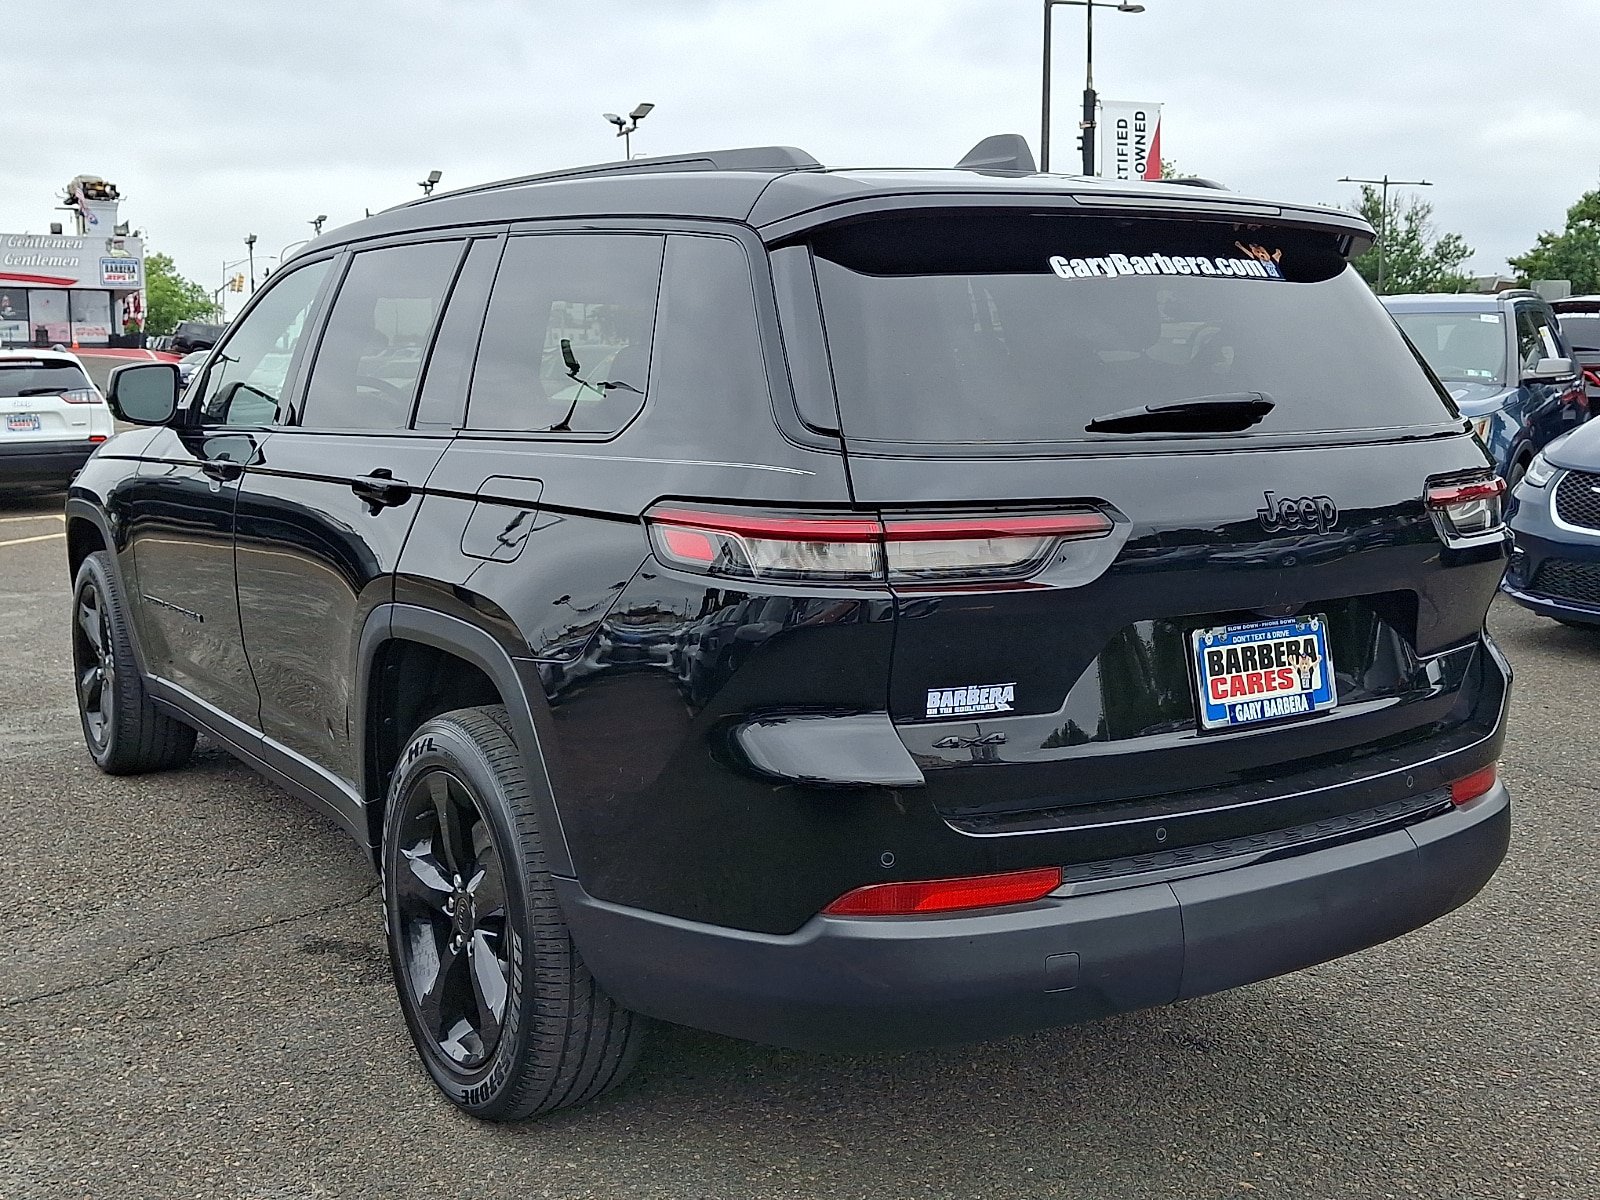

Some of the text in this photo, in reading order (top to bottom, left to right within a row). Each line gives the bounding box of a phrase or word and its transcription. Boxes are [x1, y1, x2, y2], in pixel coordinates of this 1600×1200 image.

[7, 236, 83, 249] Gentlemen
[4, 253, 79, 266] Gentlemen
[1049, 252, 1268, 279] GaryBarbera.com
[1257, 490, 1338, 535] Jeep
[1232, 634, 1250, 643] DON'T
[1251, 632, 1266, 641] TEXT
[1272, 629, 1290, 638] DRIVE
[1242, 623, 1259, 631] DOWN
[1280, 618, 1296, 626] DOWN
[1207, 638, 1317, 677] BARBERA
[926, 685, 1014, 708] BARBERA
[1210, 668, 1294, 700] CARES
[1235, 694, 1310, 722] GARY BARBERA
